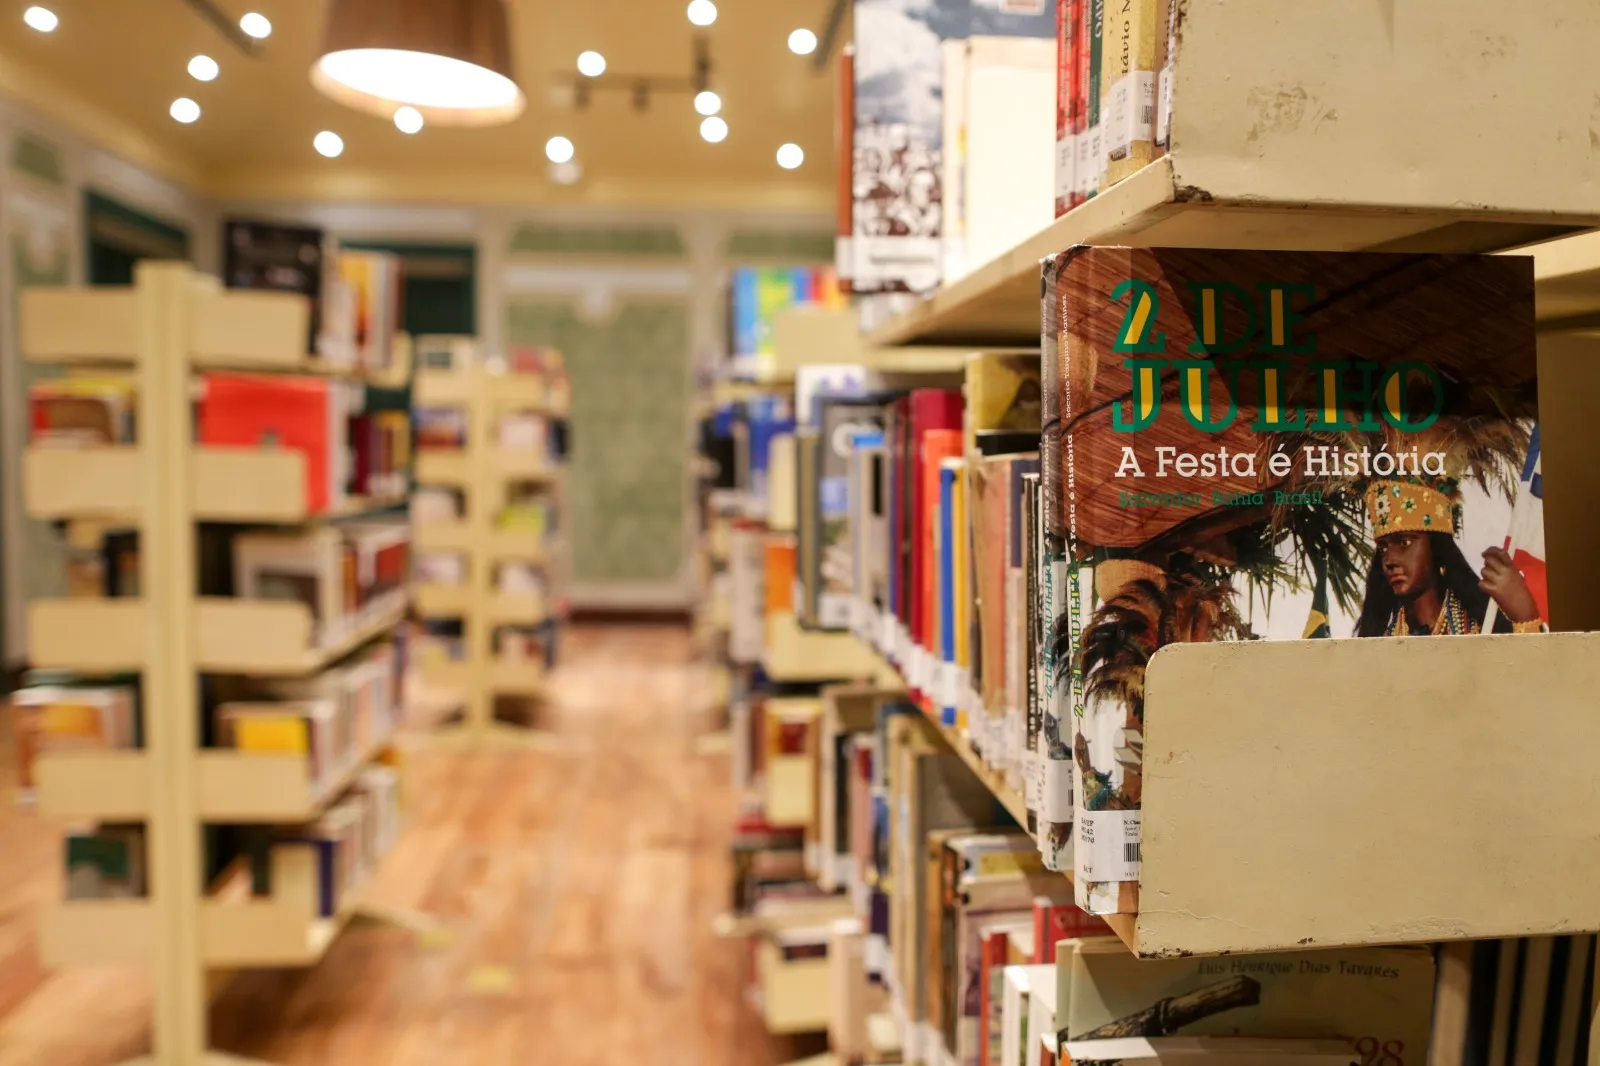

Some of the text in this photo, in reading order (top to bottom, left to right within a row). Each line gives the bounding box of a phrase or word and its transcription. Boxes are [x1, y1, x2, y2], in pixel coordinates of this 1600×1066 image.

[1110, 278, 1317, 355] 2 DE
[1112, 359, 1444, 433] JULHO
[1066, 434, 1075, 489] História
[1114, 443, 1447, 478] A Festa é História
[1118, 489, 1324, 508] Salvador Bahia Brasil
